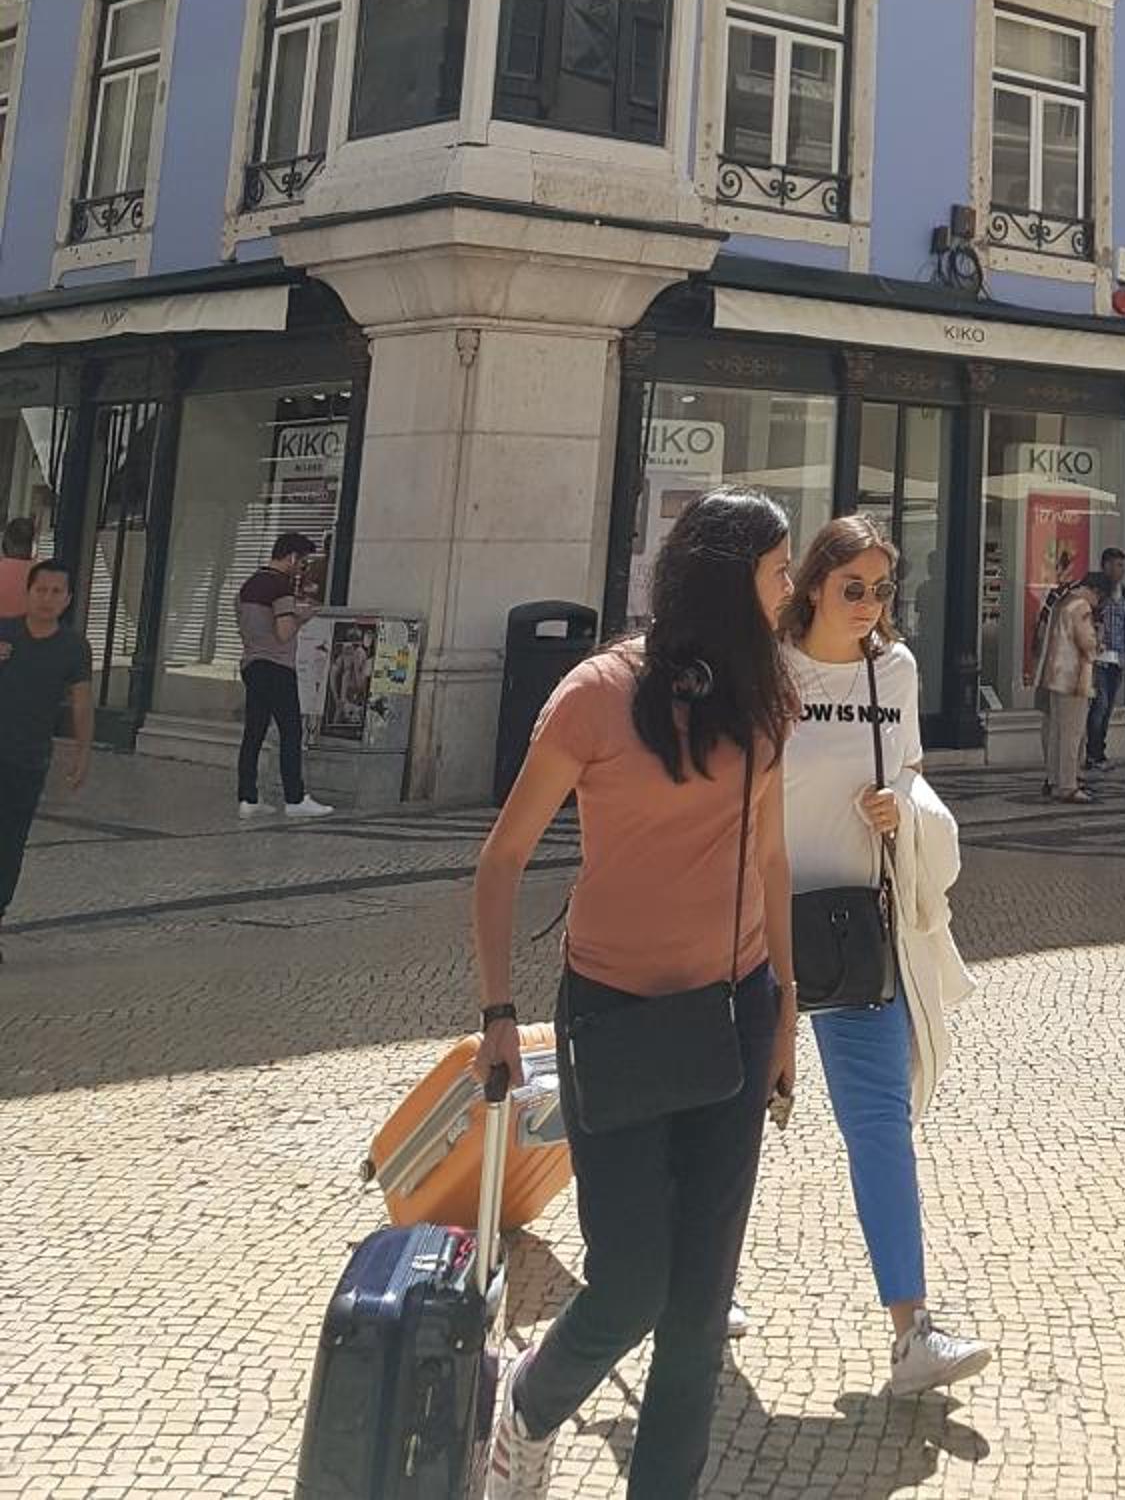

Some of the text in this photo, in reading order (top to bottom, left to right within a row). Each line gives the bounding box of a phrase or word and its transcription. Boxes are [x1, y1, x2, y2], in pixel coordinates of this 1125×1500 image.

[944, 325, 985, 343] KIKO
[281, 431, 340, 457] KIKO
[650, 426, 715, 454] IKO
[1029, 448, 1093, 475] KIKO
[800, 703, 901, 725] OW IS NOW
